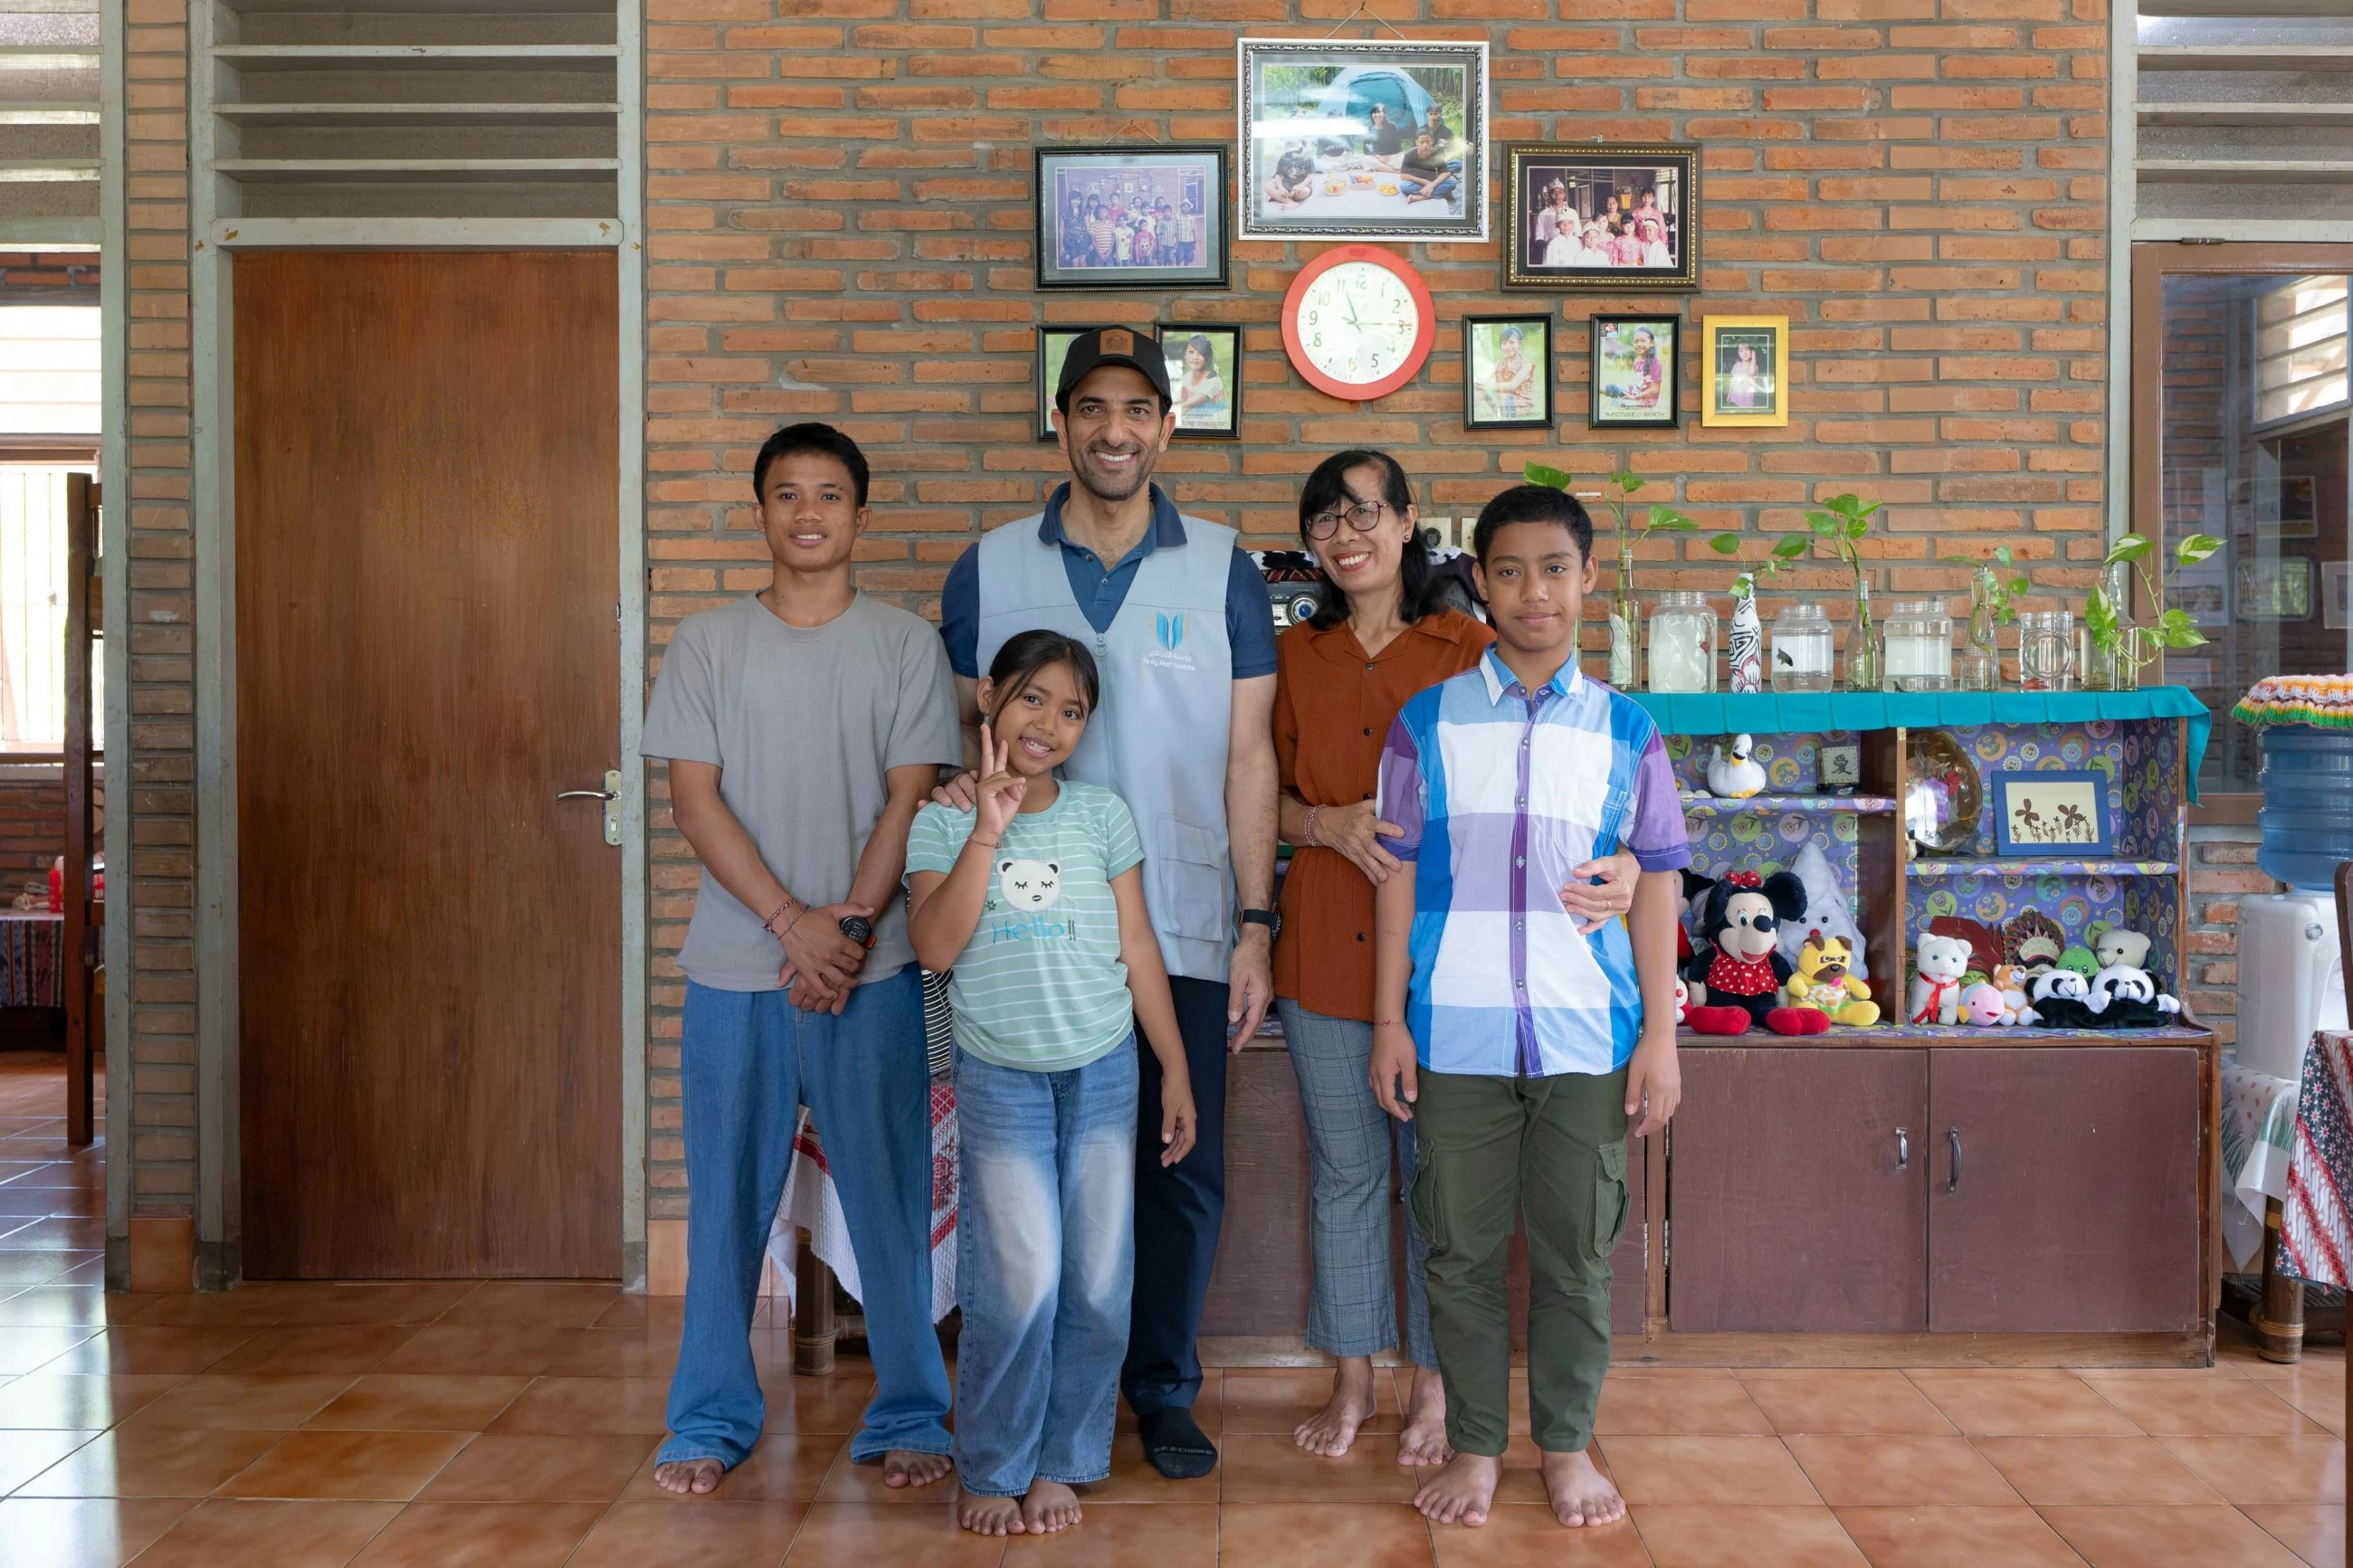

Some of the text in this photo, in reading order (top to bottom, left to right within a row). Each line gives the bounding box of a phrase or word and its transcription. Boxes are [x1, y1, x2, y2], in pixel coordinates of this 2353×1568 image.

[1337, 278, 1346, 292] 11
[1356, 274, 1367, 290] 12
[1380, 282, 1386, 298] 1
[1318, 291, 1330, 307] 10
[1391, 299, 1401, 314] 2
[1309, 310, 1319, 326] 9
[1396, 319, 1405, 335] 3
[1313, 332, 1322, 347] 8
[1370, 354, 1379, 368] 5
[1831, 754, 1853, 774] 愛
